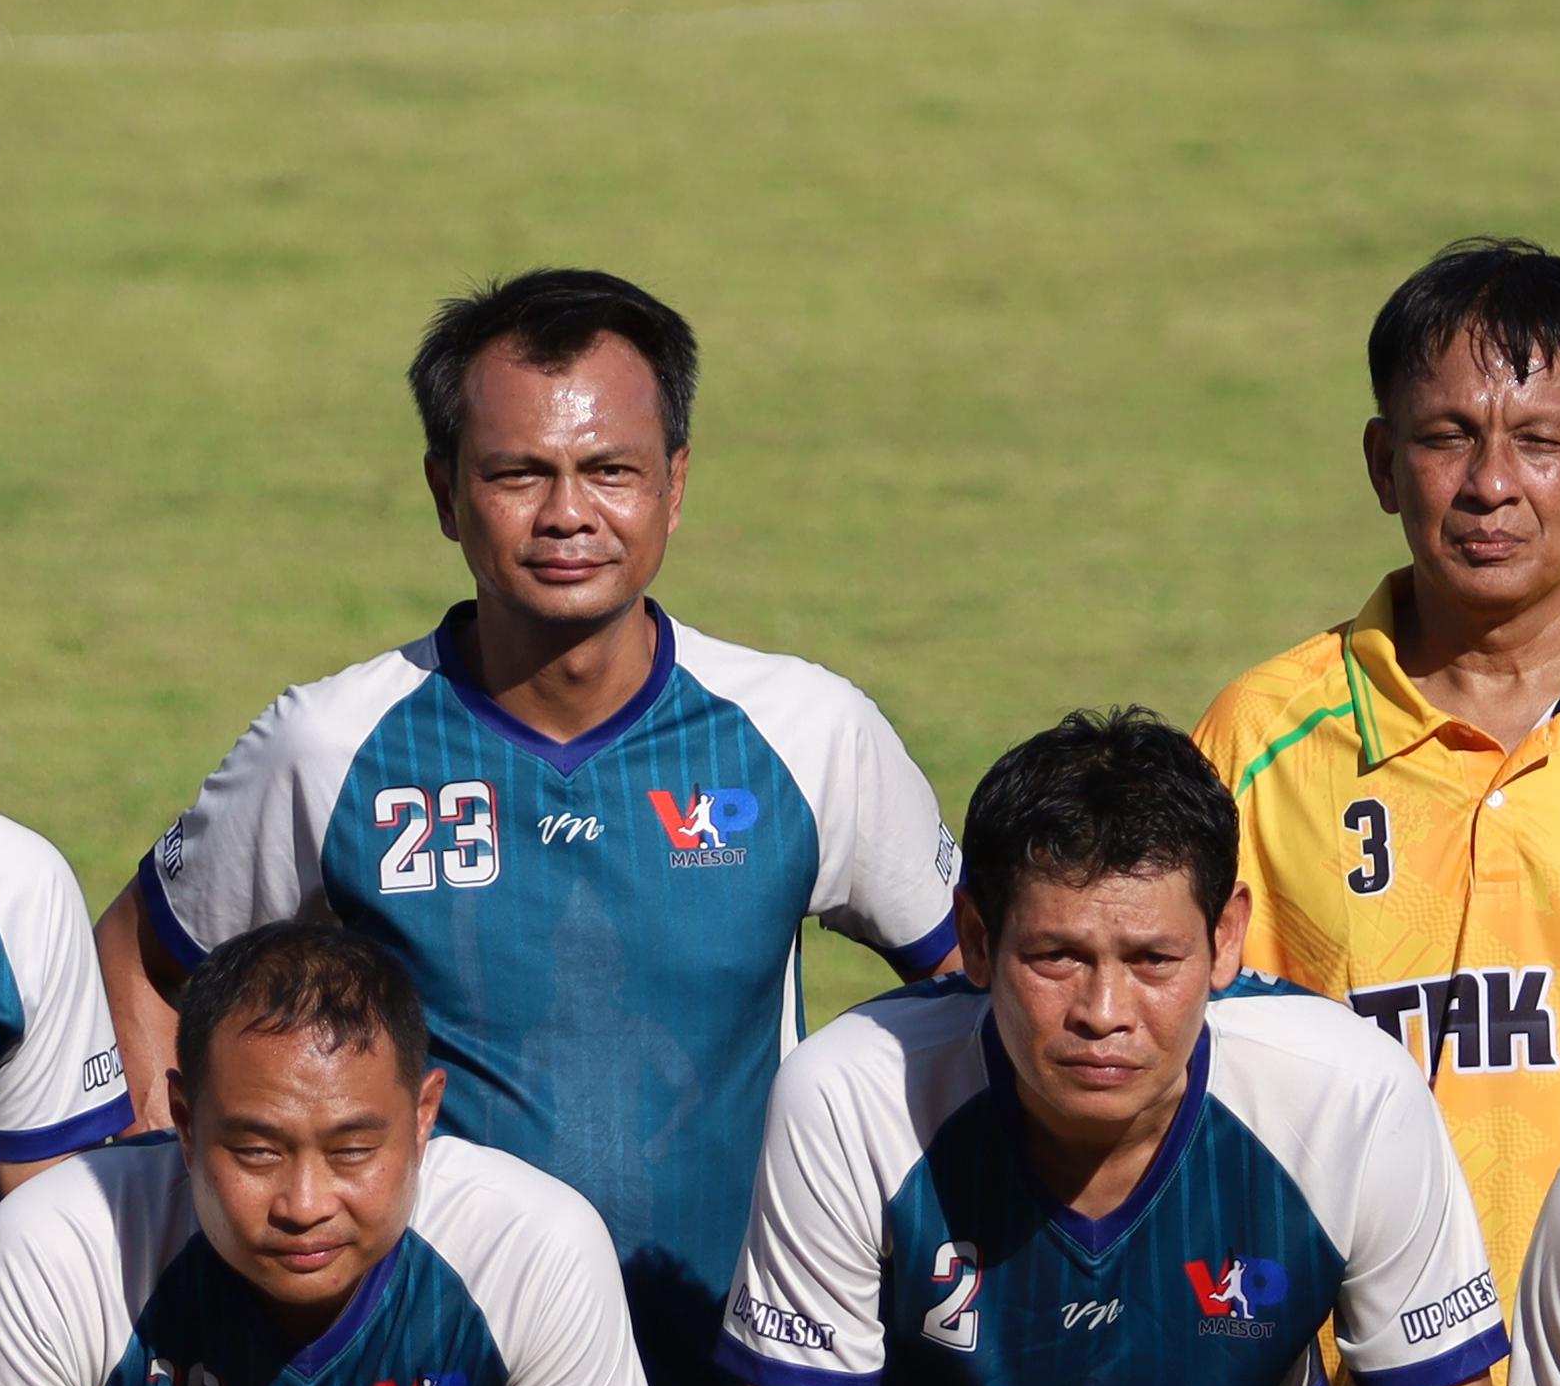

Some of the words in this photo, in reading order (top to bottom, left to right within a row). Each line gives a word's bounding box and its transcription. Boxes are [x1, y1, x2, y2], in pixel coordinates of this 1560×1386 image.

[374, 780, 500, 894] 23
[669, 849, 746, 868] MAESOT
[1342, 798, 1392, 895] 3
[1348, 970, 1558, 1083] TAK
[83, 1051, 111, 1092] VIP
[920, 1239, 980, 1352] 2
[1198, 1317, 1275, 1338] MAESOT
[1400, 1303, 1444, 1344] VIP
